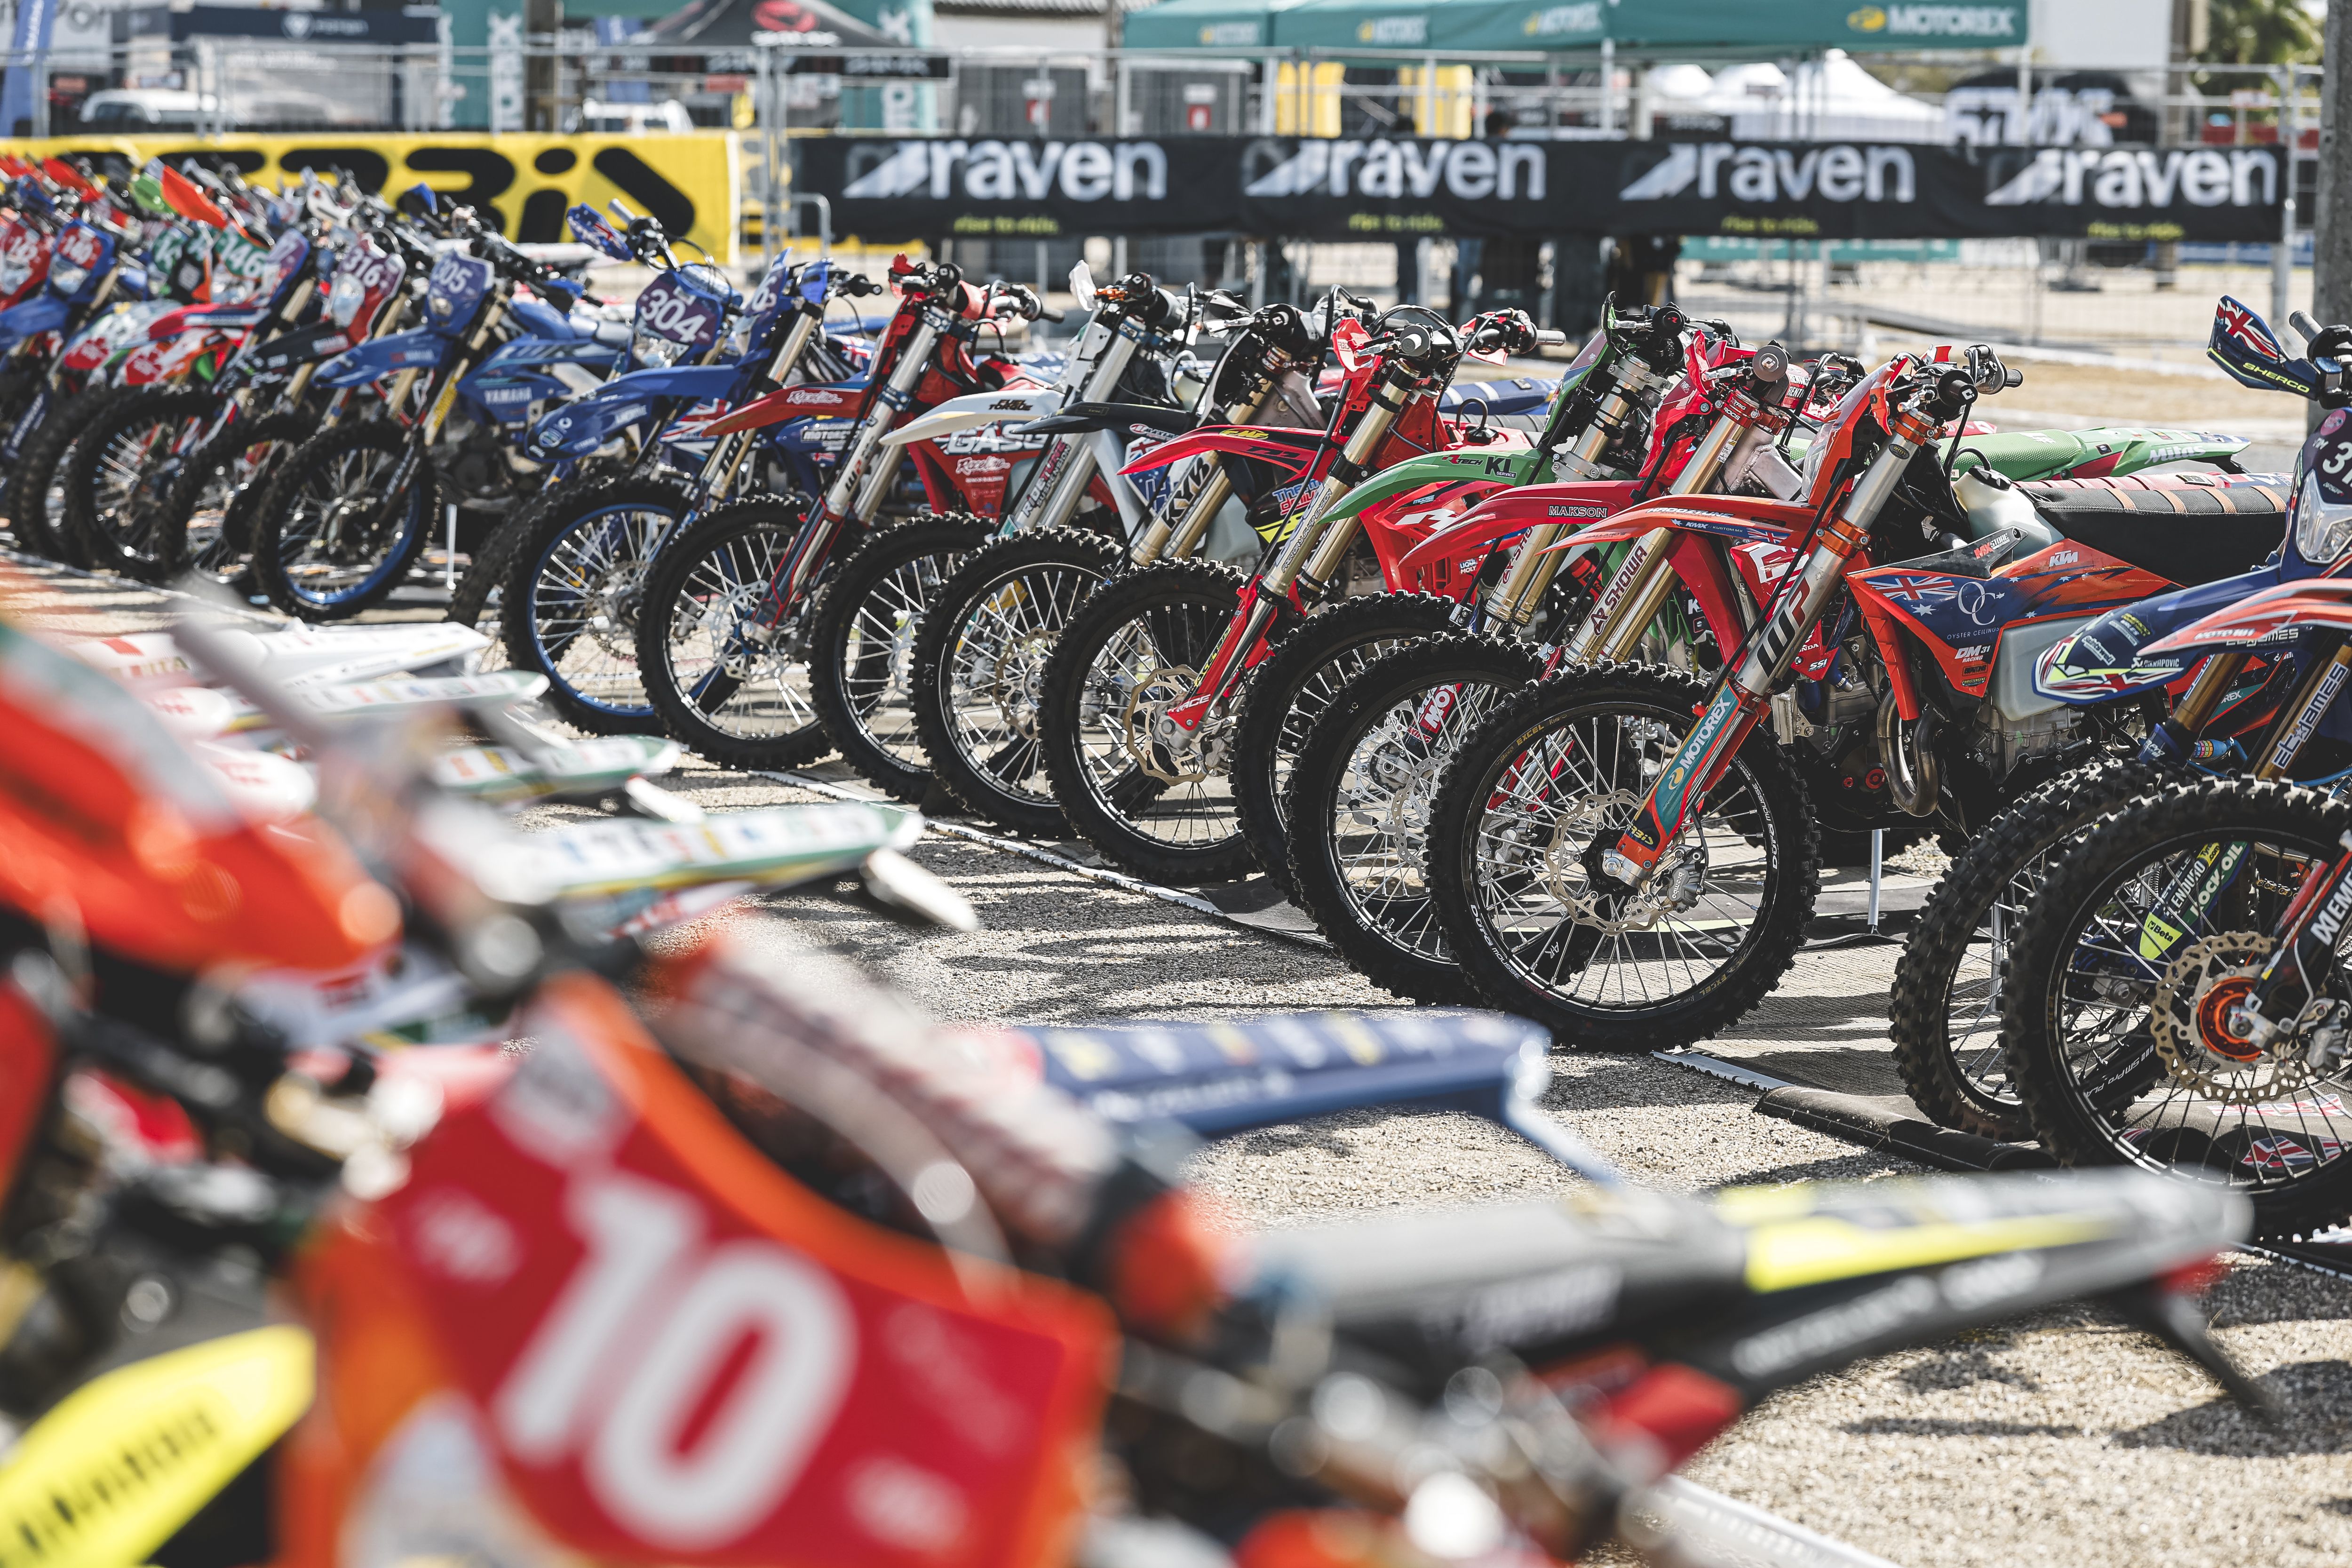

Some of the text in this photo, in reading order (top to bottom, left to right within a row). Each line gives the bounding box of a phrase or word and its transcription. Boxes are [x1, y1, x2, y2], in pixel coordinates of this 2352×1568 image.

[1888, 6, 2016, 36] MOTOREX
[930, 141, 1168, 201] raven
[1329, 140, 1546, 200] raven
[1698, 144, 1916, 202] raven
[2071, 149, 2278, 208] raven
[222, 234, 269, 279] 146
[342, 250, 383, 284] 316
[432, 257, 473, 293] 305
[641, 288, 707, 343] 304
[2242, 361, 2310, 393] SHERCO
[1724, 407, 1740, 421] ROCS
[1731, 397, 1747, 411] XTRIG
[1220, 429, 1268, 439] FMF
[2145, 446, 2206, 465] Mitas
[1161, 456, 1213, 532] KYB
[1413, 494, 1435, 504] MOOSE
[1549, 505, 1608, 518] MAKSON
[1685, 521, 1709, 530] KMX
[1281, 489, 1332, 573] FACTORY SUSPENSION
[1460, 558, 1478, 568] LIQUI
[1460, 565, 1477, 575] MOLY
[2049, 550, 2078, 567] KTM
[1604, 545, 1648, 612] SHOWA
[1757, 577, 1811, 678] WP
[1947, 627, 2000, 640] OYSTER CEILINGS
[1809, 658, 1828, 670] SSI
[1955, 645, 1991, 660] DM 31
[1962, 655, 1983, 663] RACING
[1516, 724, 1545, 746] EXCEL
[1679, 697, 1732, 769] MOTOREX
[1752, 782, 1771, 821] MOUSSE
[1671, 870, 1686, 899] brembo
[2170, 860, 2207, 908] ENDURO
[2190, 844, 2244, 917] ROCK OIL
[2153, 925, 2174, 943] Beta
[1492, 947, 1522, 980] MOUSSE
[494, 1169, 861, 1552] 10
